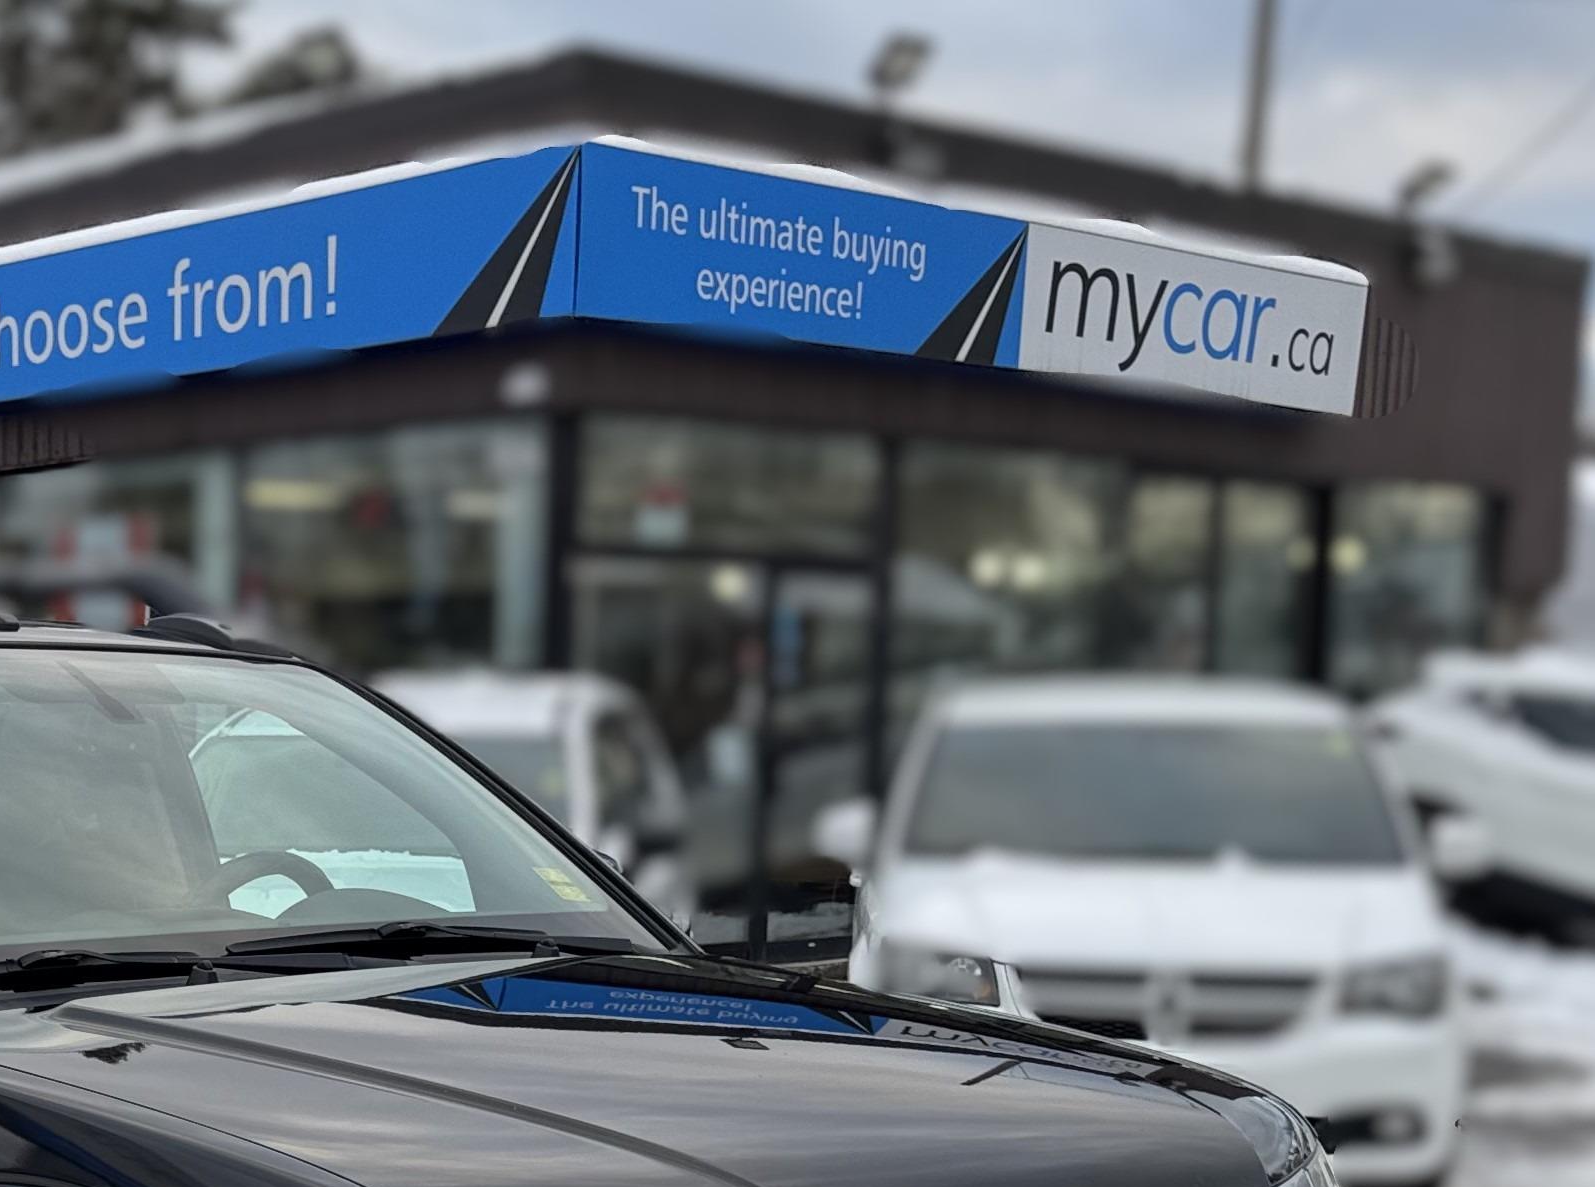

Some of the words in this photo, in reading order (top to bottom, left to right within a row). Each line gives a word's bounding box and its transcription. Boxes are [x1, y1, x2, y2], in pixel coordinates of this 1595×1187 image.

[630, 185, 688, 237] The
[698, 205, 824, 258] ultimate
[832, 216, 927, 283] buying
[166, 234, 338, 342] from!
[696, 267, 864, 320] experience!
[1044, 259, 1335, 373] mycar.ca
